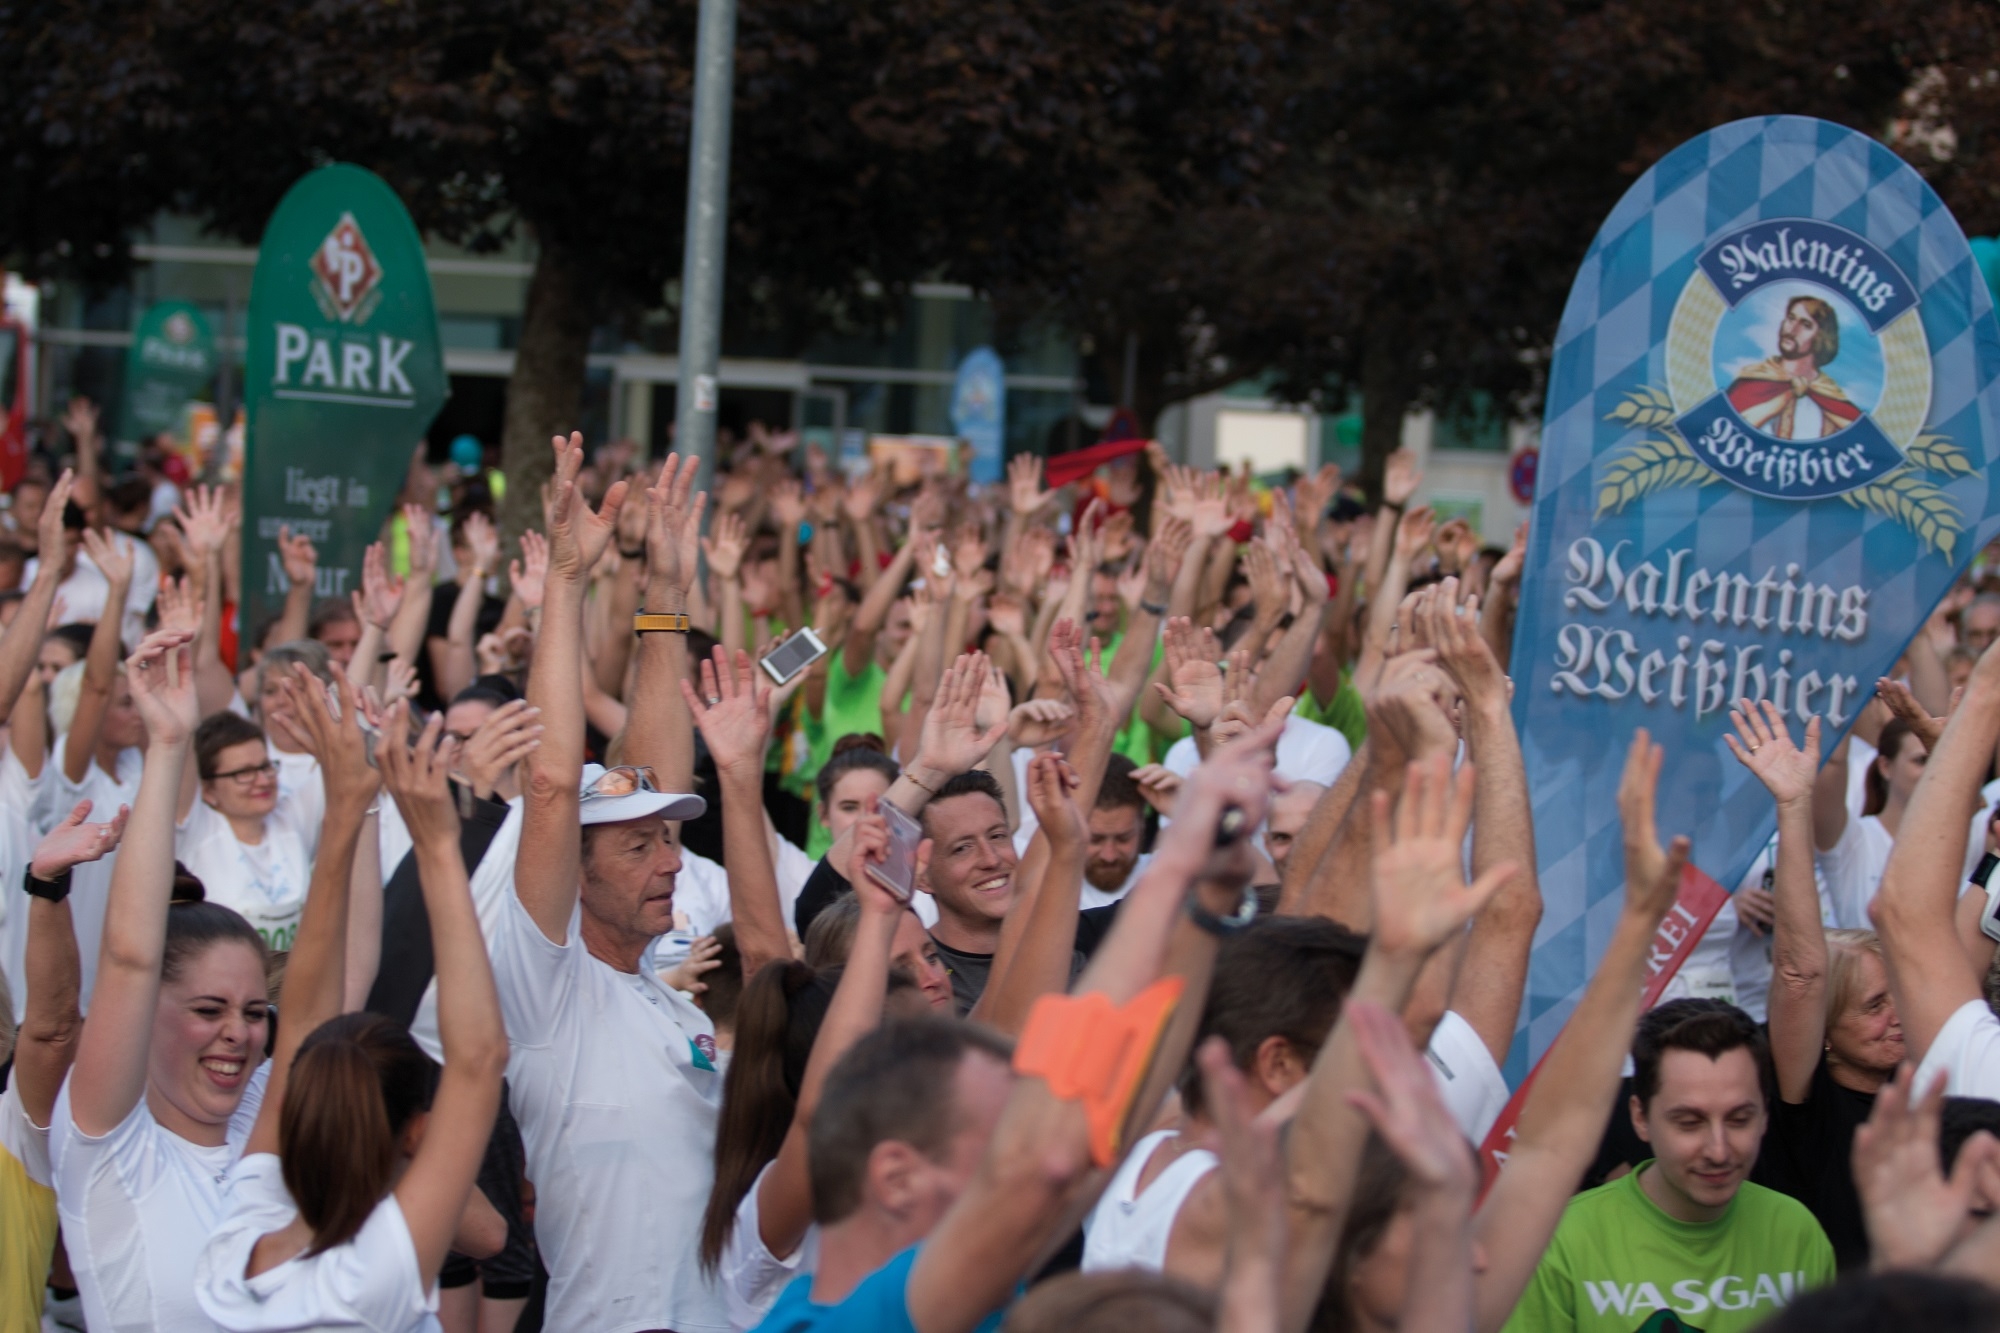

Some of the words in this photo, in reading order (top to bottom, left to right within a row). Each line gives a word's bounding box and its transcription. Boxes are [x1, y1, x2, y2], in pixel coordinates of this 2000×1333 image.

[1718, 227, 1897, 313] Valentins
[273, 322, 415, 396] PARK
[1698, 416, 1873, 490] Weißbier
[265, 550, 350, 598] Nur
[1563, 536, 1872, 641] Valentins
[1550, 621, 1858, 729] Weißbier
